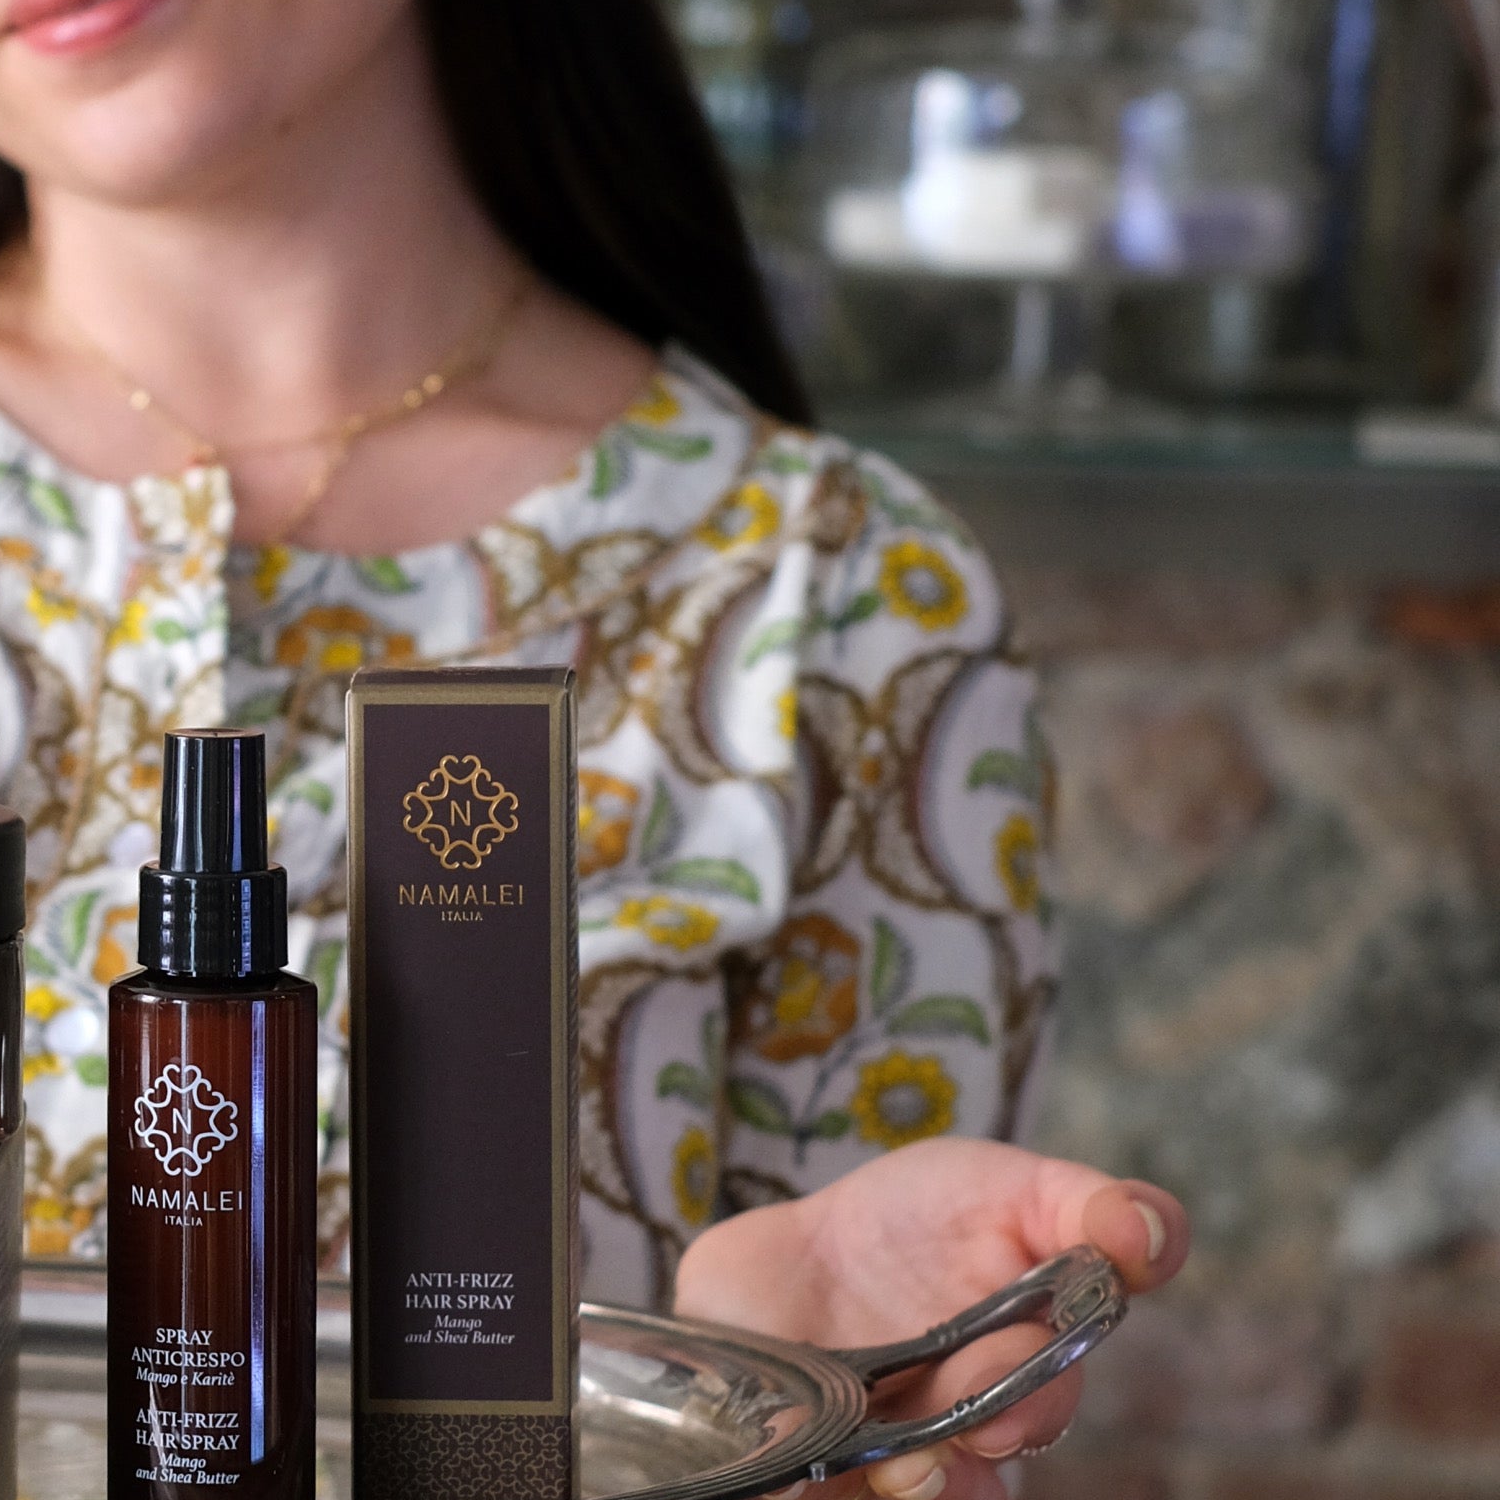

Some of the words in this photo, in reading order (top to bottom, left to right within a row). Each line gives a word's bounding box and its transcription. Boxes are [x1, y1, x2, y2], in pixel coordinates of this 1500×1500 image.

[398, 884, 523, 906] NAMALEI
[441, 911, 484, 922] ITALIA
[131, 1184, 243, 1211] NAMALEI
[164, 1215, 203, 1227] ITALIA
[406, 1272, 514, 1288] ANTI-FRIZZ
[405, 1294, 453, 1309] HAIR
[457, 1294, 515, 1310] SPRAY
[434, 1314, 483, 1332] Mango
[156, 1327, 213, 1346] SPRAY
[405, 1330, 432, 1343] and
[435, 1330, 468, 1344] Shea
[472, 1331, 515, 1344] Butter
[131, 1346, 245, 1368] ANTICRESPO
[136, 1366, 177, 1388] Mango
[181, 1374, 188, 1385] e
[191, 1371, 235, 1386] Karitè
[136, 1408, 239, 1429] ANTI-FRIZZ
[136, 1429, 178, 1449] HAIR
[181, 1435, 240, 1450] SPRAY
[160, 1453, 206, 1472] Mango
[136, 1467, 157, 1480] and
[160, 1468, 193, 1484] Shea
[196, 1470, 240, 1485] Butter
